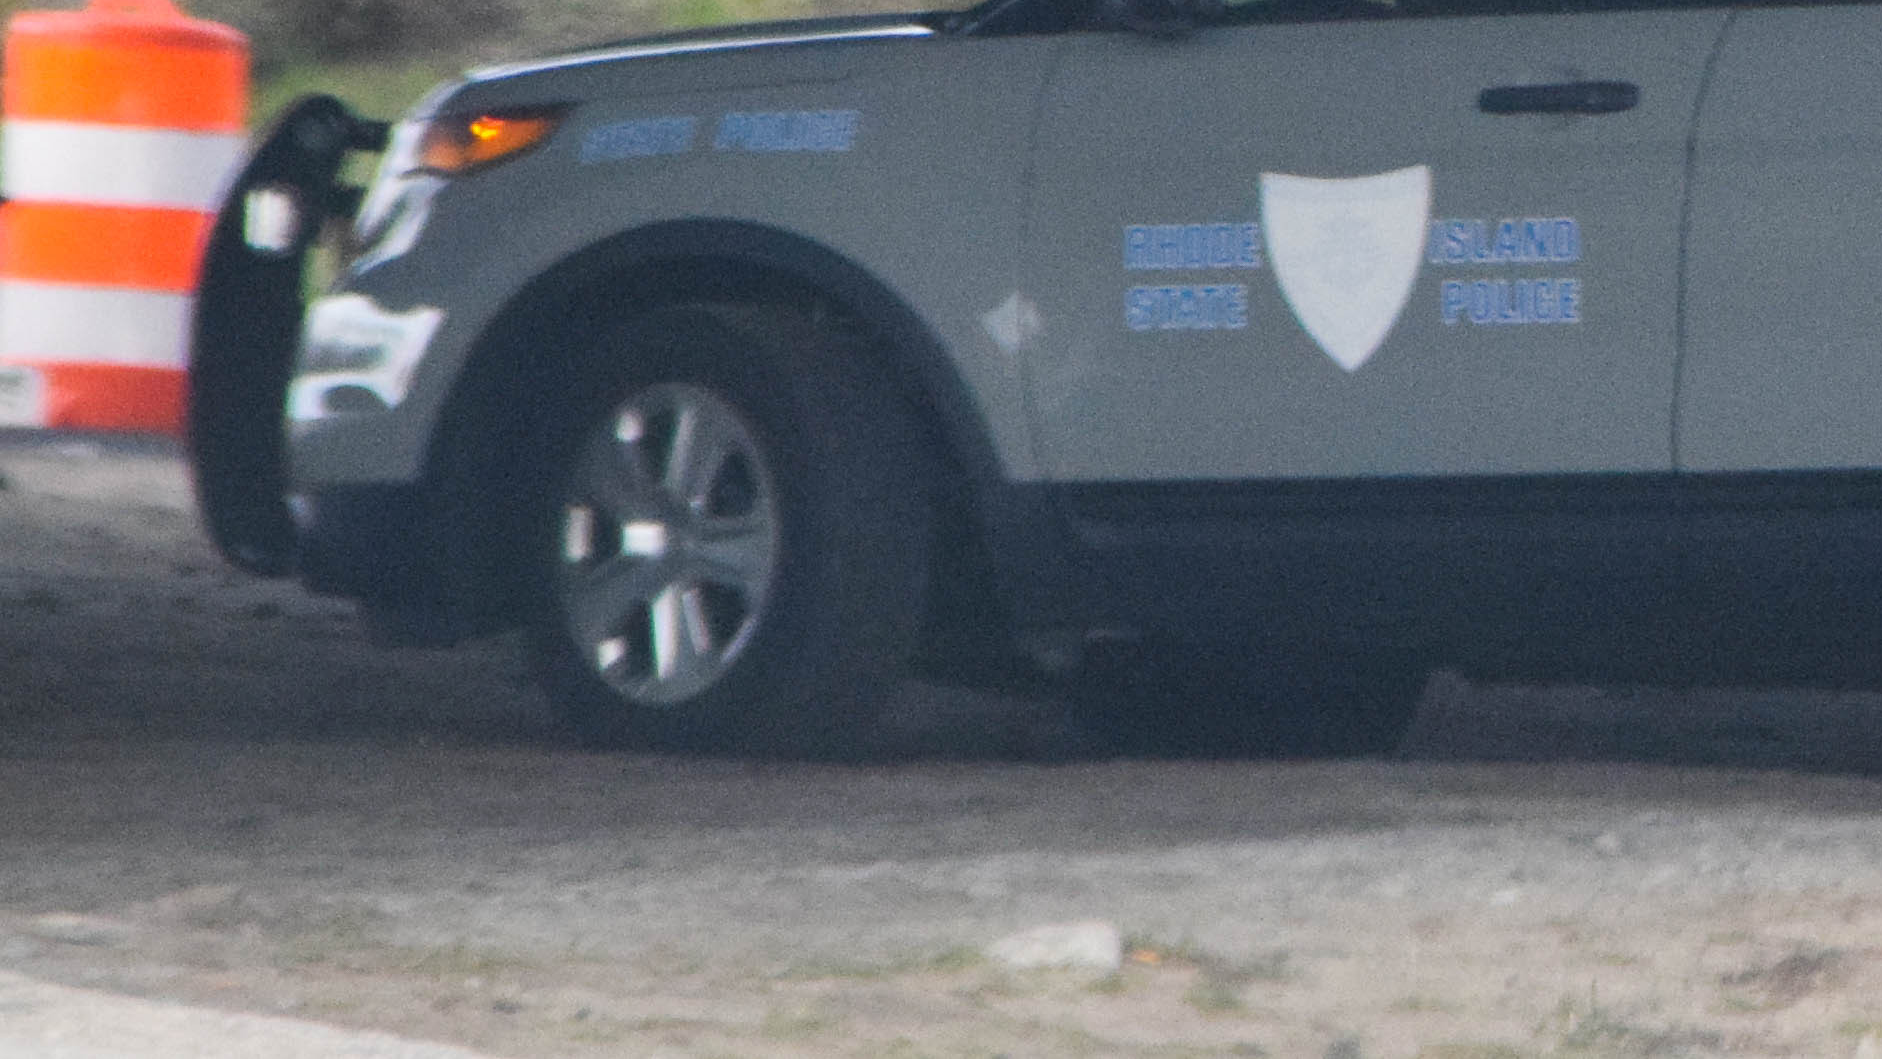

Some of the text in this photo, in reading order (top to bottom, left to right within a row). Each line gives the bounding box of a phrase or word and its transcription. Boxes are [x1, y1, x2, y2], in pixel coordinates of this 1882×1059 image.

[1123, 217, 1582, 270] RHODE ISLAND
[1124, 278, 1582, 331] STATE POLICE
